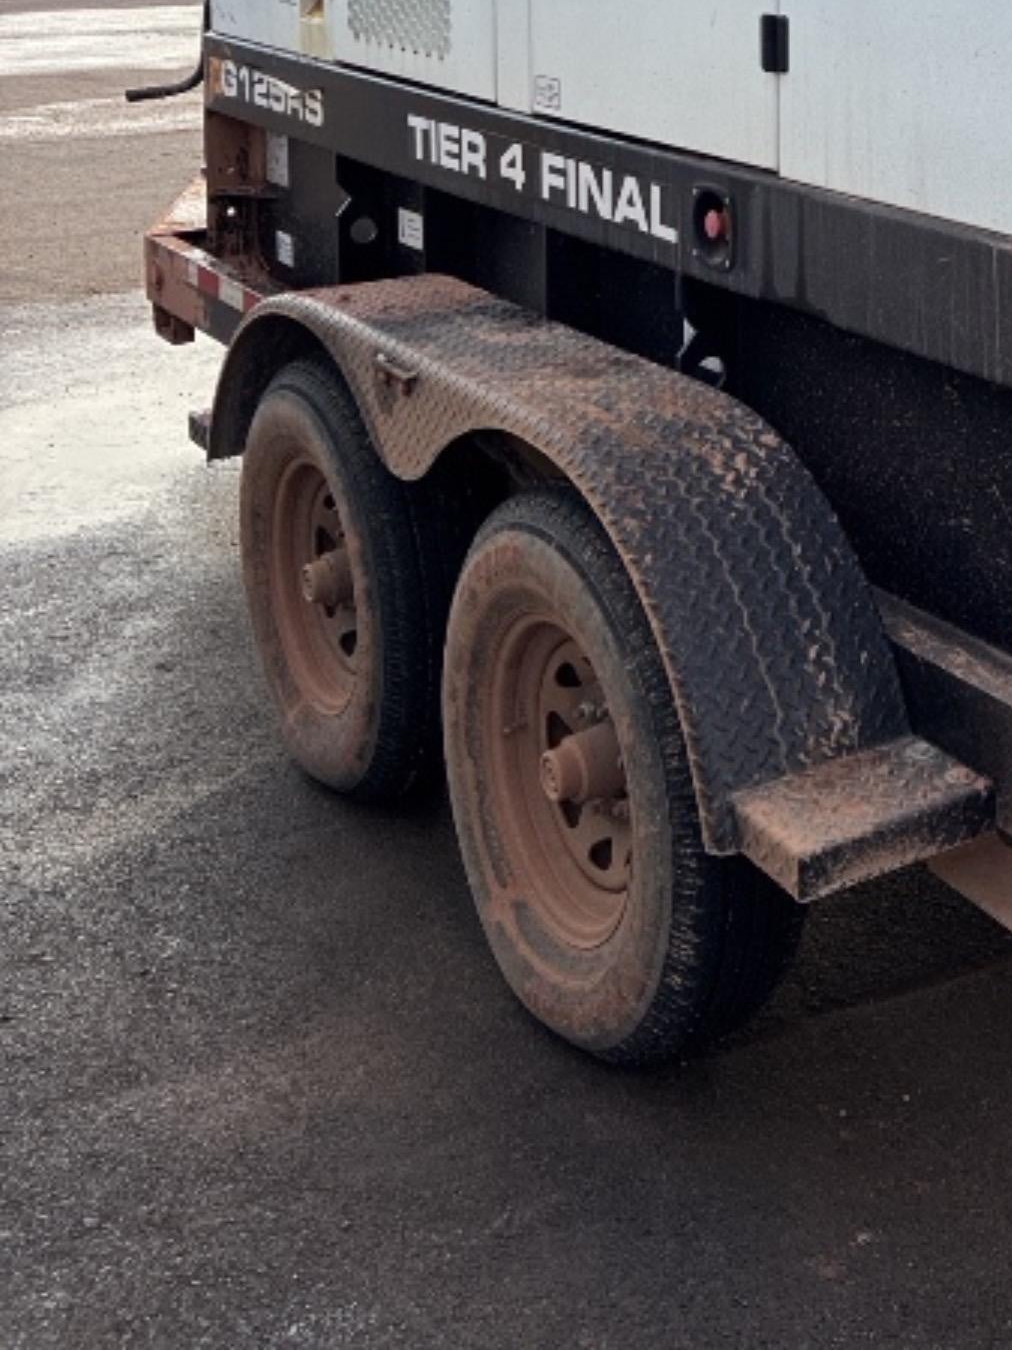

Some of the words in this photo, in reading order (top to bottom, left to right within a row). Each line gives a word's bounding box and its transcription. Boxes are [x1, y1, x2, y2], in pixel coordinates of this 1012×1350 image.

[407, 113, 486, 180] TIER
[500, 143, 526, 191] 4
[541, 151, 678, 244] FINAL
